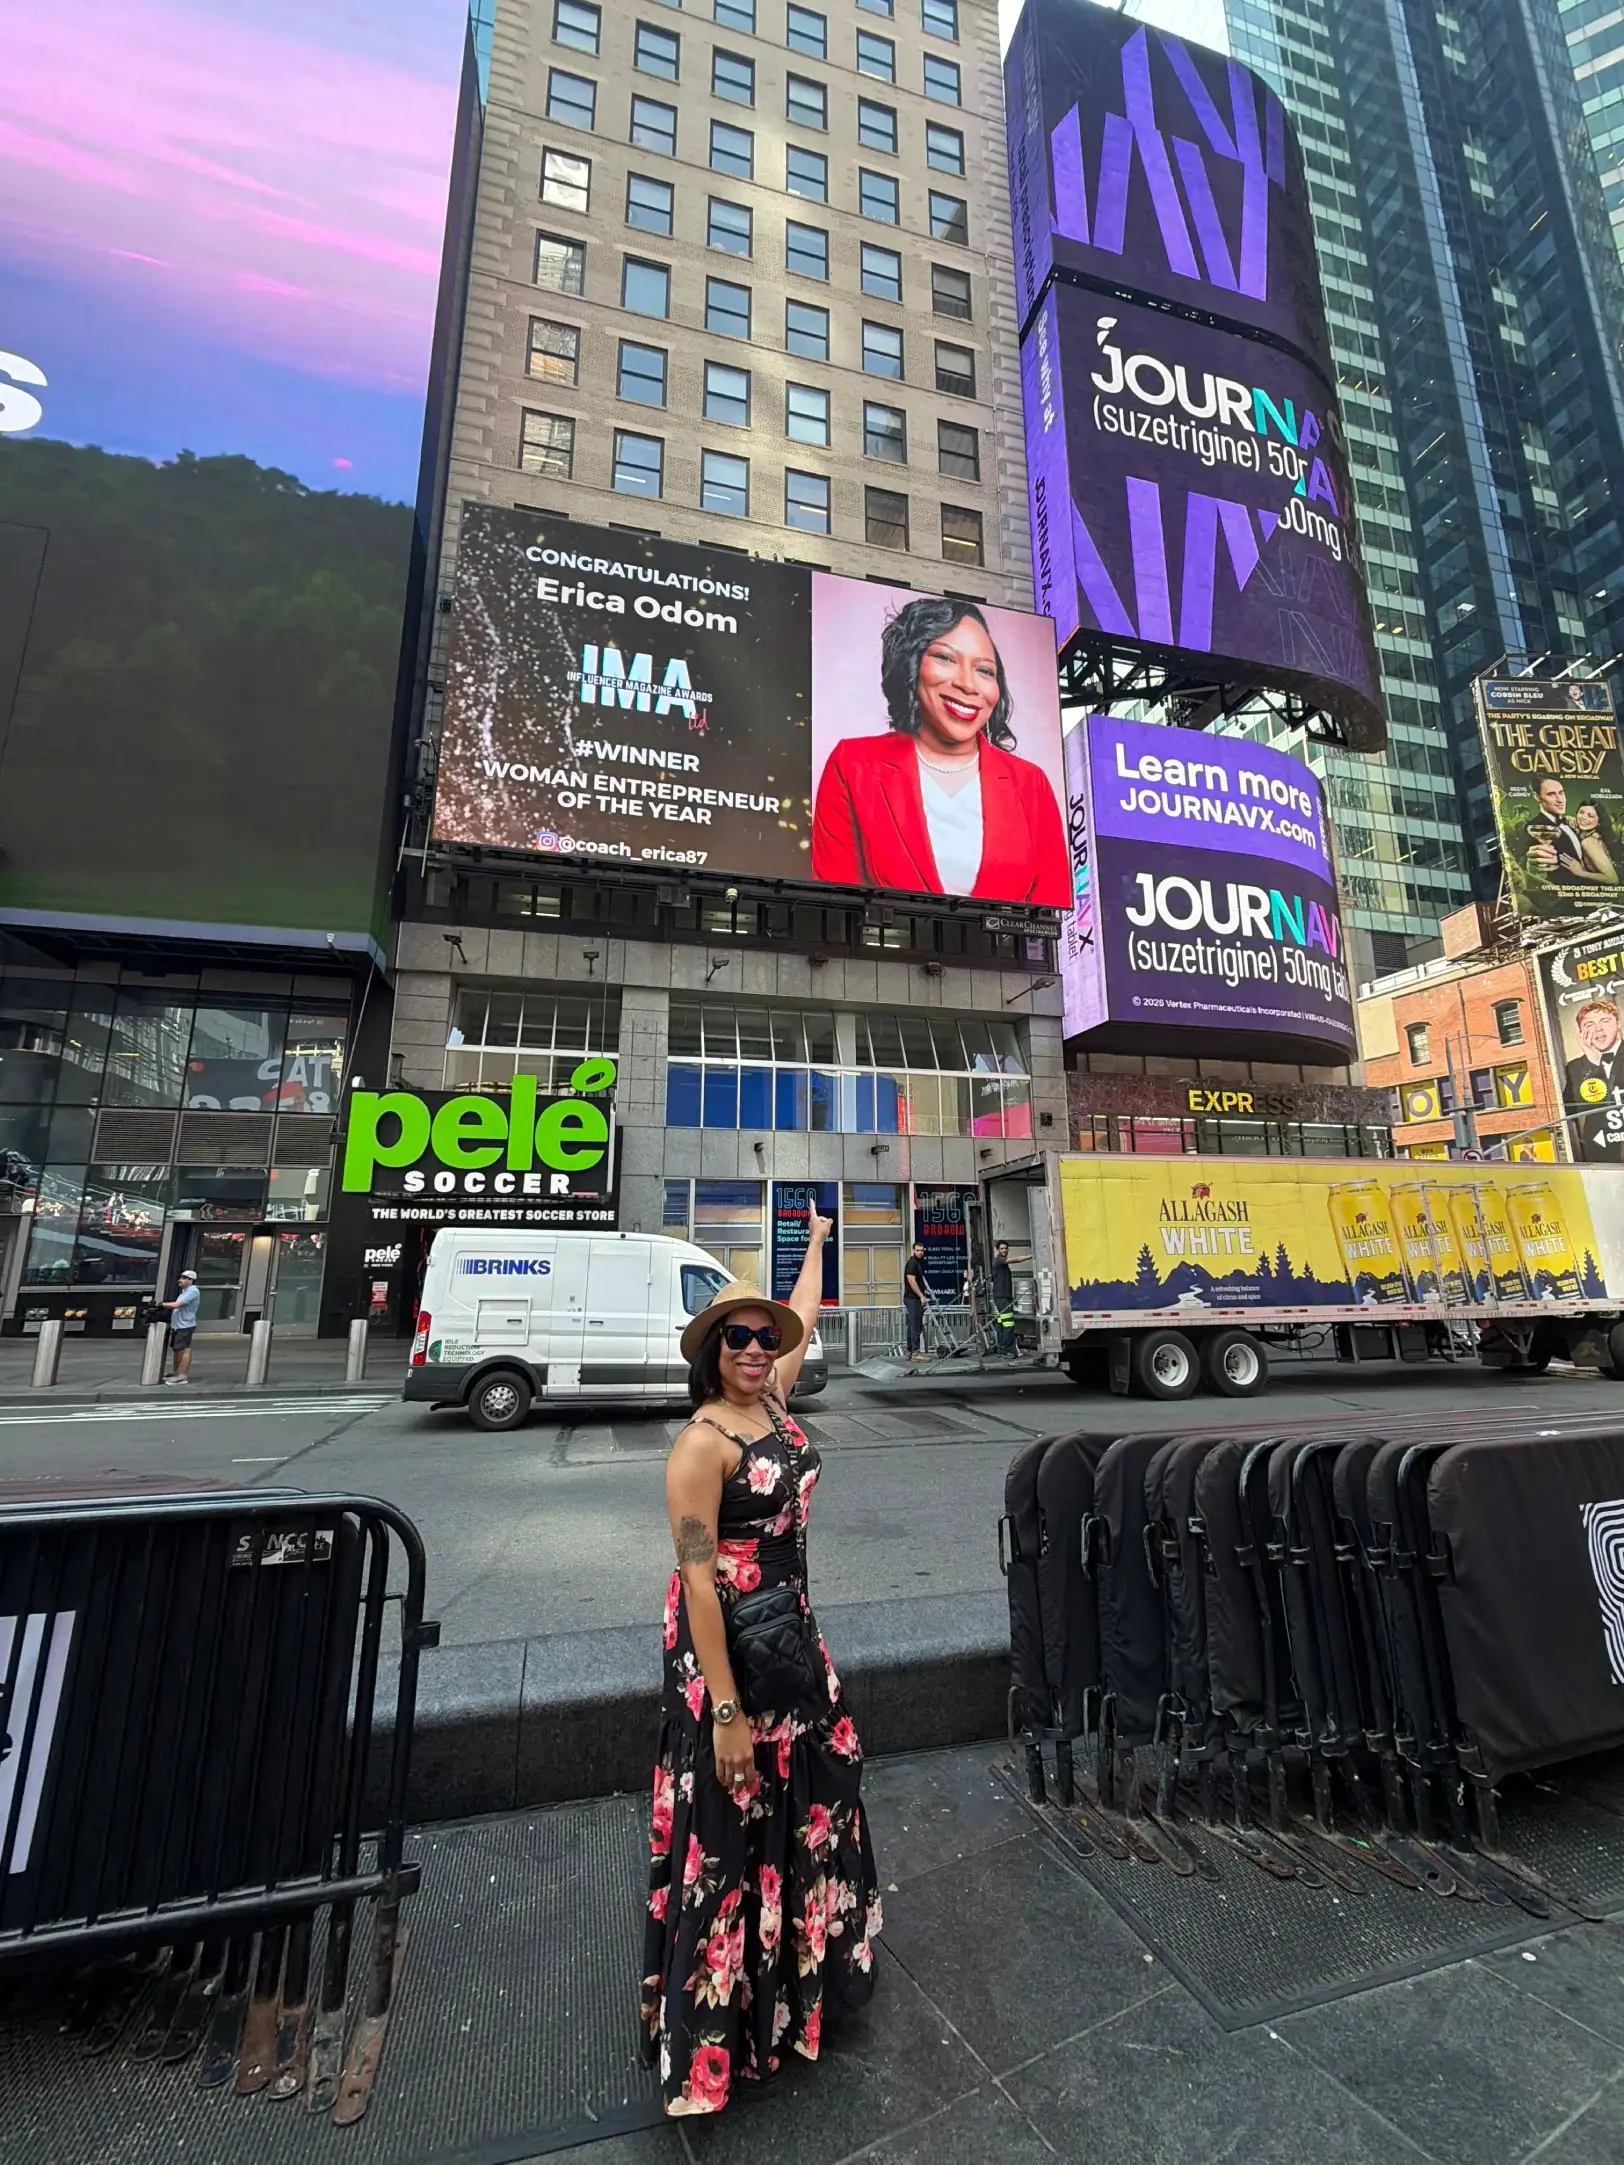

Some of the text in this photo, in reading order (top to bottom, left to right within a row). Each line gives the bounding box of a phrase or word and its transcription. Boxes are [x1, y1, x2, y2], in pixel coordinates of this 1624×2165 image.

[1037, 310, 1048, 357] See
[1040, 360, 1055, 405] why
[1093, 395, 1260, 472] (suzetrigine)
[525, 546, 750, 601] CONGRATULATIONS!
[536, 576, 738, 634] Erica Odom
[566, 671, 713, 703] INFLUENCER MAGAZINE AWARDS
[580, 644, 697, 719] IMA
[1490, 723, 1617, 749] THE GREAT
[574, 739, 700, 773] #WINNER
[1511, 749, 1607, 774] GATSBY
[482, 759, 780, 814] WOMAN ENTREPRENEUR
[1115, 743, 1313, 818] Learn more
[557, 790, 712, 826] OF THE YEAR
[1120, 787, 1317, 850] JOURNAVX.com
[558, 836, 708, 866] @coach_erica87
[1069, 792, 1094, 954] JOURNAVX
[1128, 931, 1278, 987] (suzetrigine)
[1283, 947, 1332, 1002] 50mg
[1576, 953, 1618, 982] BEST
[1166, 1000, 1192, 1009] Vertex
[1193, 1002, 1257, 1014] Pharmaceuticals
[1499, 1071, 1528, 1103] Y
[342, 1057, 616, 1193] pelé
[403, 1169, 571, 1194] SOCCER
[371, 1208, 615, 1221] THE WORLD'S GREATEST SOCCER STORE
[777, 1220, 802, 1228] Retail/
[1158, 1198, 1250, 1223] ALLAGASH
[777, 1235, 800, 1243] Space
[1158, 1226, 1256, 1256] WHITE
[1341, 1220, 1389, 1240] ALLAGASH
[1520, 1220, 1562, 1240] ALLAGASH
[364, 1243, 403, 1263] pelé
[1344, 1237, 1395, 1260] WHITE
[1406, 1236, 1454, 1259] WHTE
[1524, 1236, 1568, 1258] WHITE
[472, 1258, 551, 1276] BRINKS
